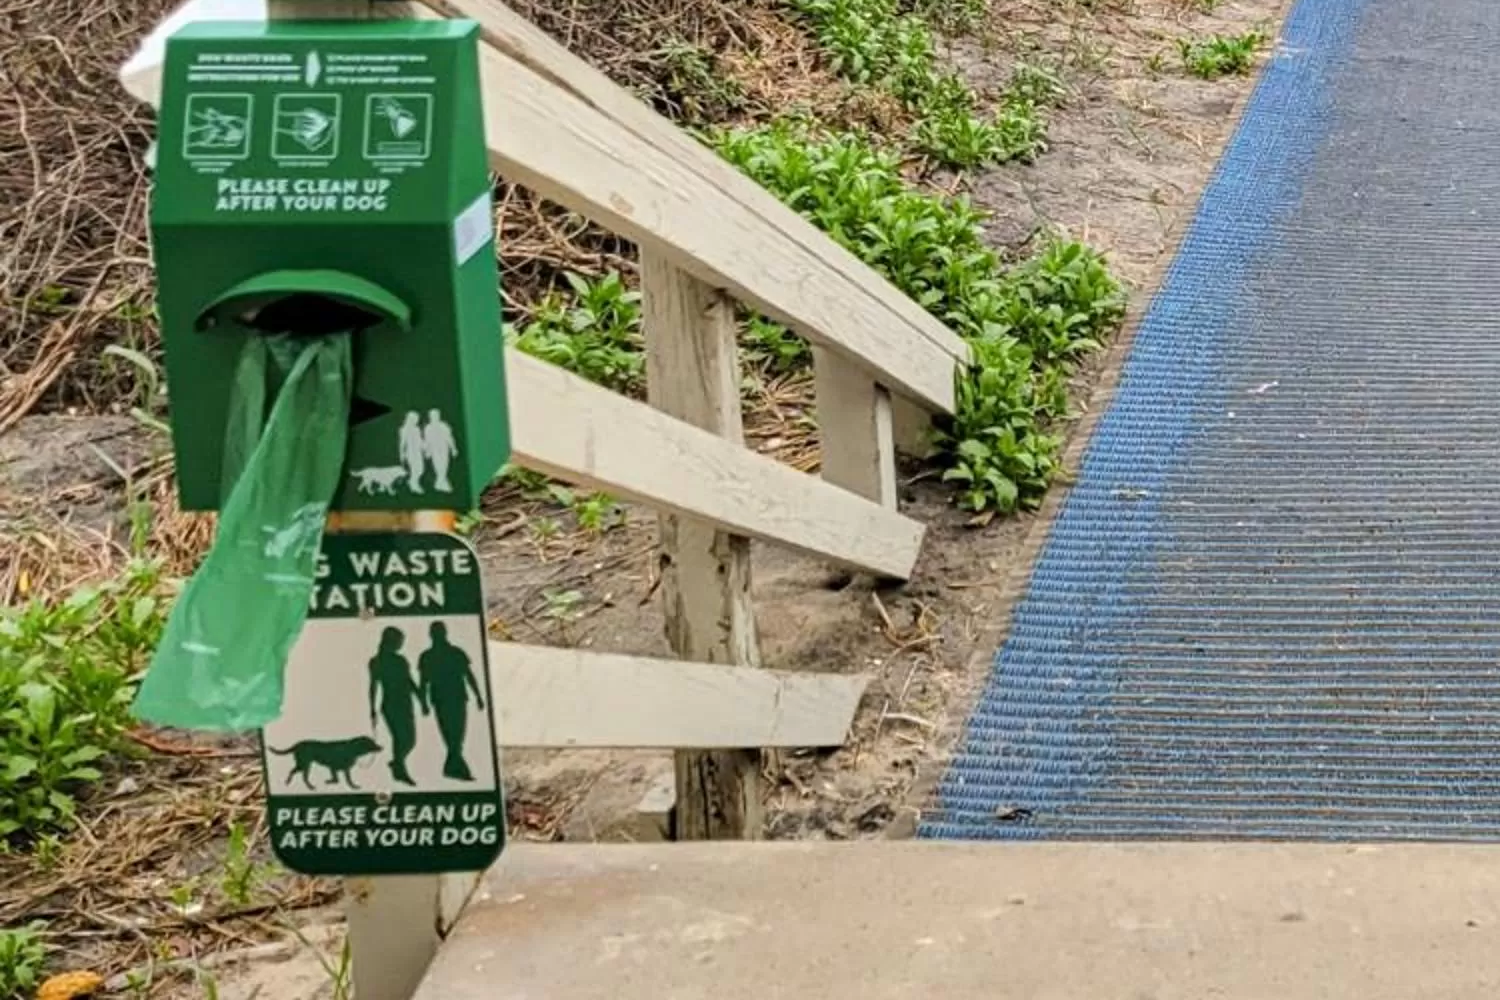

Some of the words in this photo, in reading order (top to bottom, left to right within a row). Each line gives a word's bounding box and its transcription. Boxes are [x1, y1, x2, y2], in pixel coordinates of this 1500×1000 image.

[217, 178, 289, 194] PLEASE
[293, 178, 358, 194] CLEAN
[363, 178, 391, 194] UP
[215, 195, 276, 211] AFTER
[283, 195, 337, 211] YOUR
[342, 195, 387, 211] DOG
[349, 550, 472, 578] WASTE
[309, 581, 445, 609] TATION
[276, 806, 368, 827] PLEASE
[371, 804, 455, 825] CLEAN
[460, 803, 497, 823] UP
[279, 829, 358, 849] AFTER
[364, 828, 435, 848] YOUR
[440, 826, 498, 846] DOG
